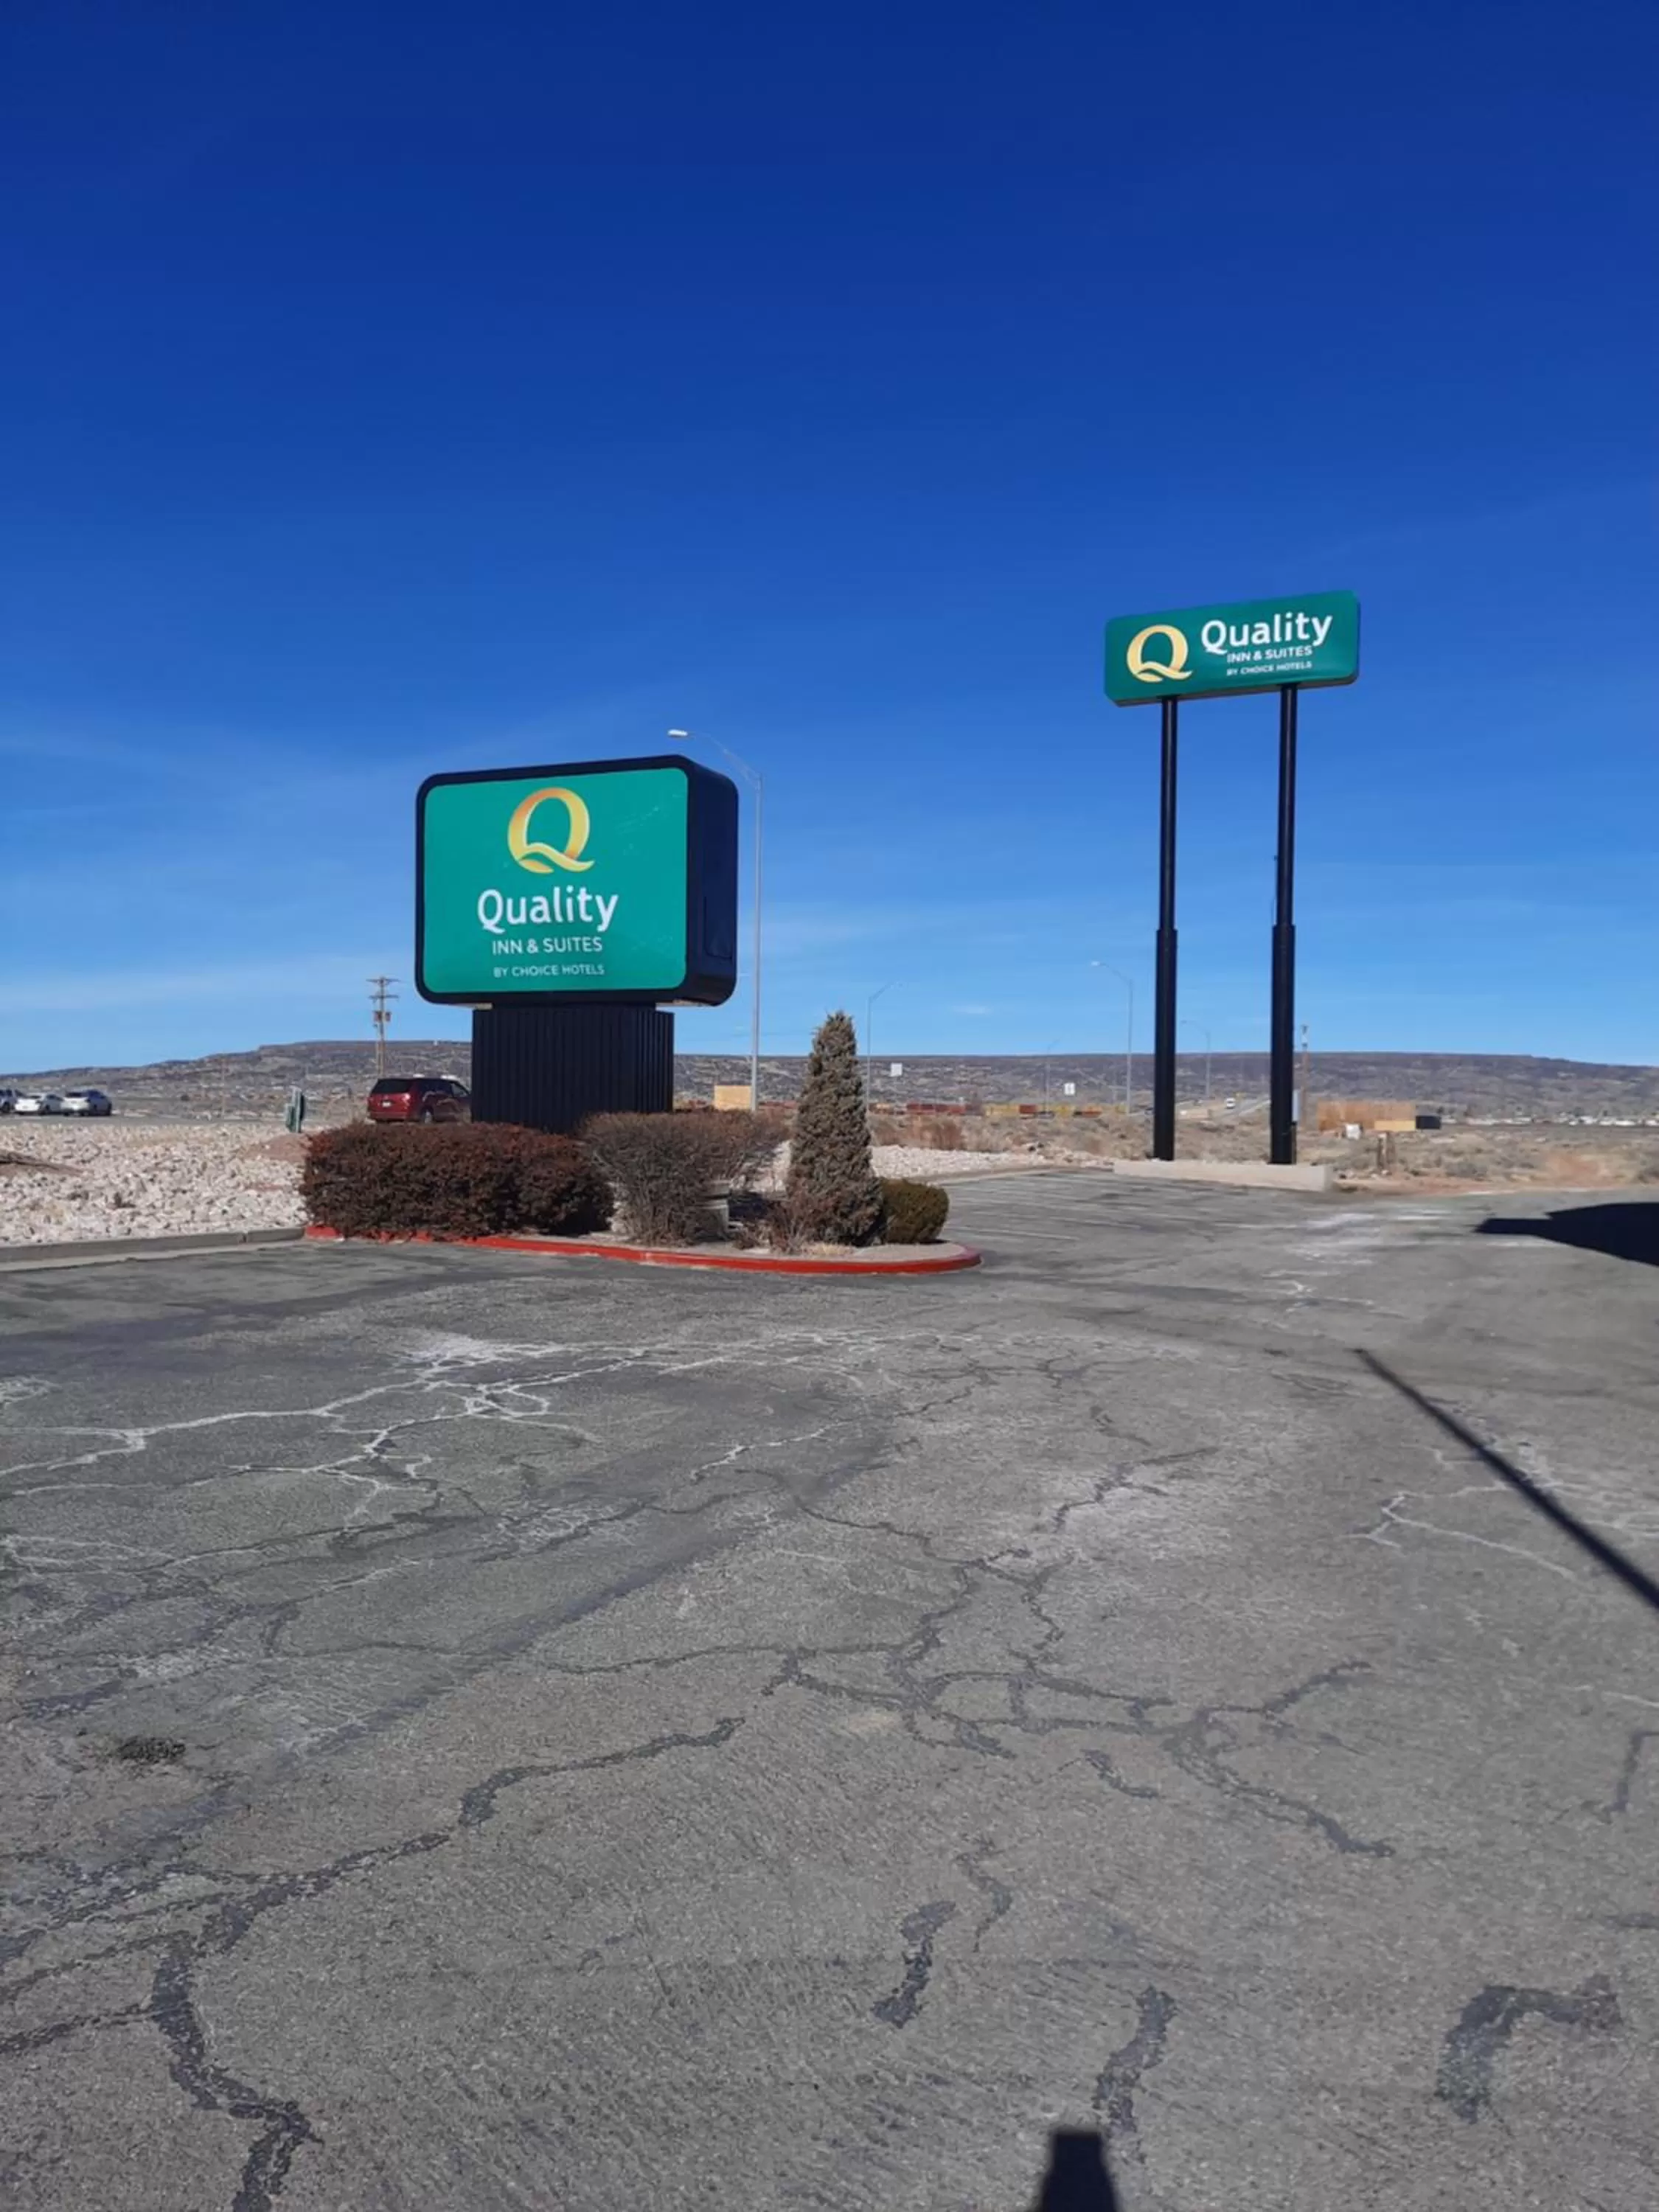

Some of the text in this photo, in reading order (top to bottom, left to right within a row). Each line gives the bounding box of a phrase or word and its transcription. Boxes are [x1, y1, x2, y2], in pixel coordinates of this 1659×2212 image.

[1201, 612, 1332, 655] Quality
[1127, 625, 1192, 683] Q
[1227, 646, 1312, 663] INN & SUITES
[1227, 661, 1312, 676] BY CHOICE HOTELS
[507, 787, 595, 873] Q
[477, 886, 619, 933] Quality
[493, 936, 602, 955] INN & SUITES
[493, 963, 605, 978] BY CHOICE HOTELS
